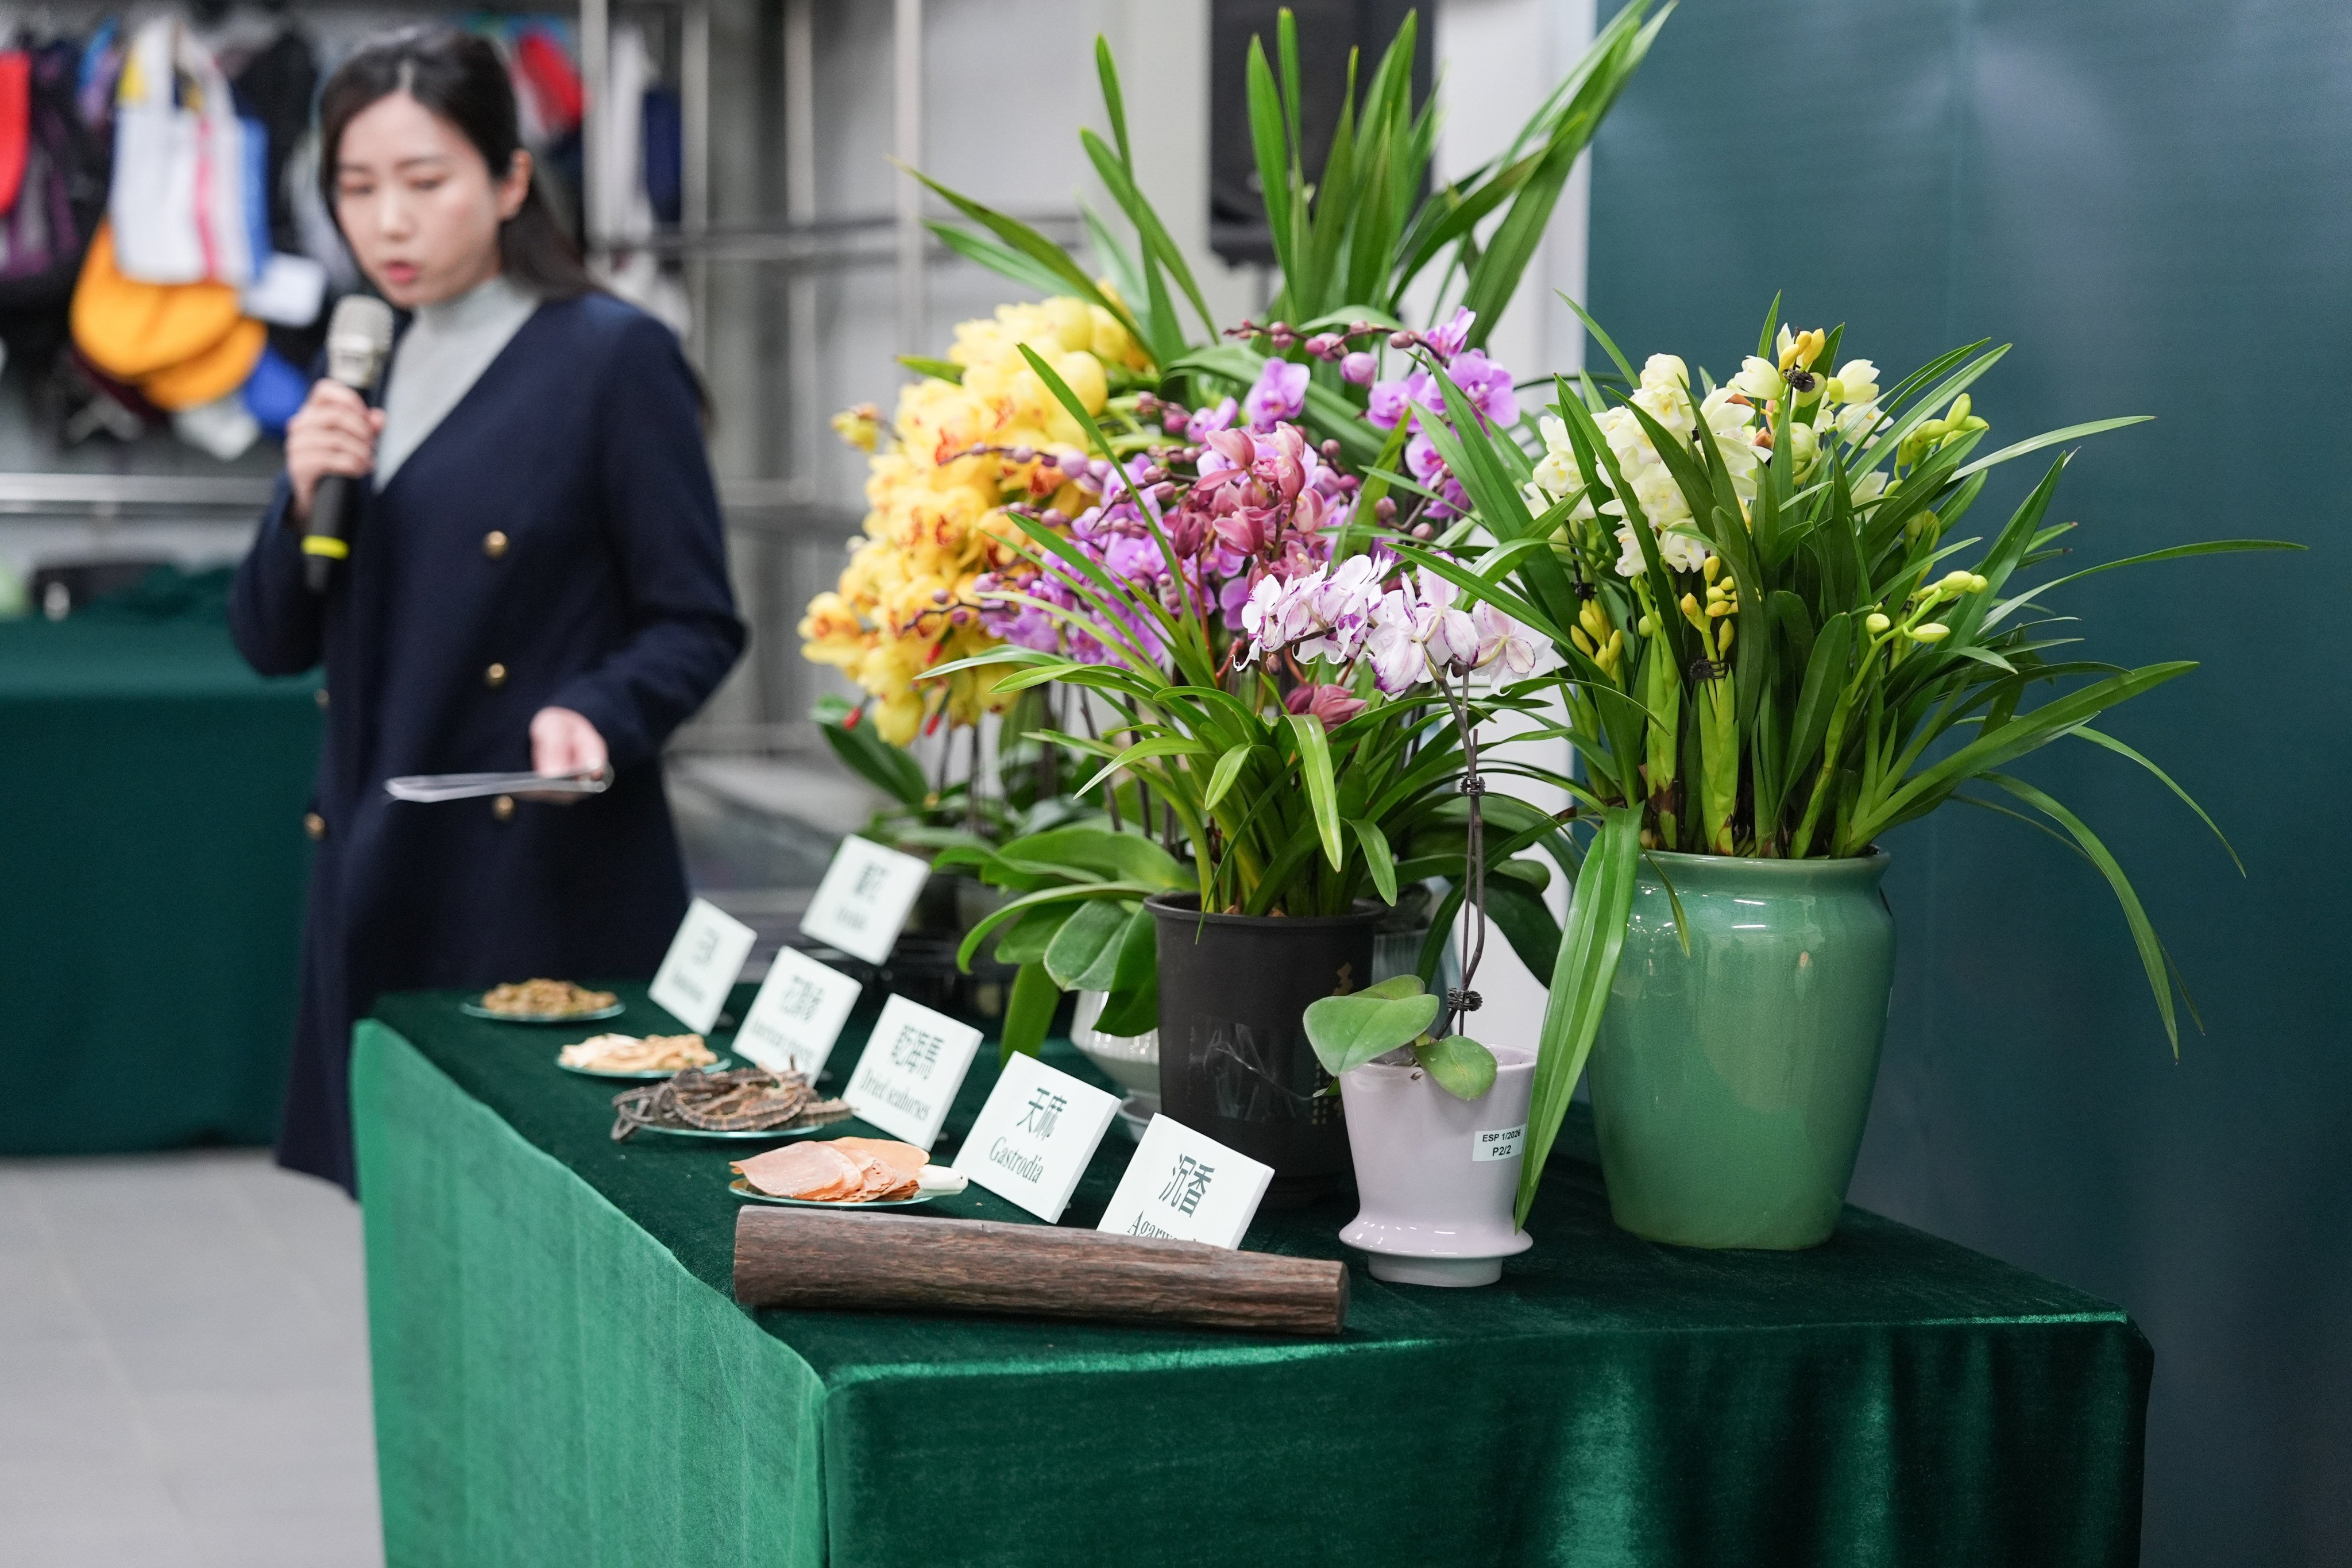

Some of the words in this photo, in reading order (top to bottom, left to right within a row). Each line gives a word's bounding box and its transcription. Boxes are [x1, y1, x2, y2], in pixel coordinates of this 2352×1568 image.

[860, 1067, 891, 1099] Dried
[1016, 1087, 1068, 1141] 天麻
[1482, 1134, 1500, 1142] ESP
[1501, 1129, 1521, 1141] 1/2026
[1492, 1145, 1512, 1156] P2/2
[990, 1136, 1043, 1183] Gastrodia
[1158, 1153, 1215, 1218] 沉香
